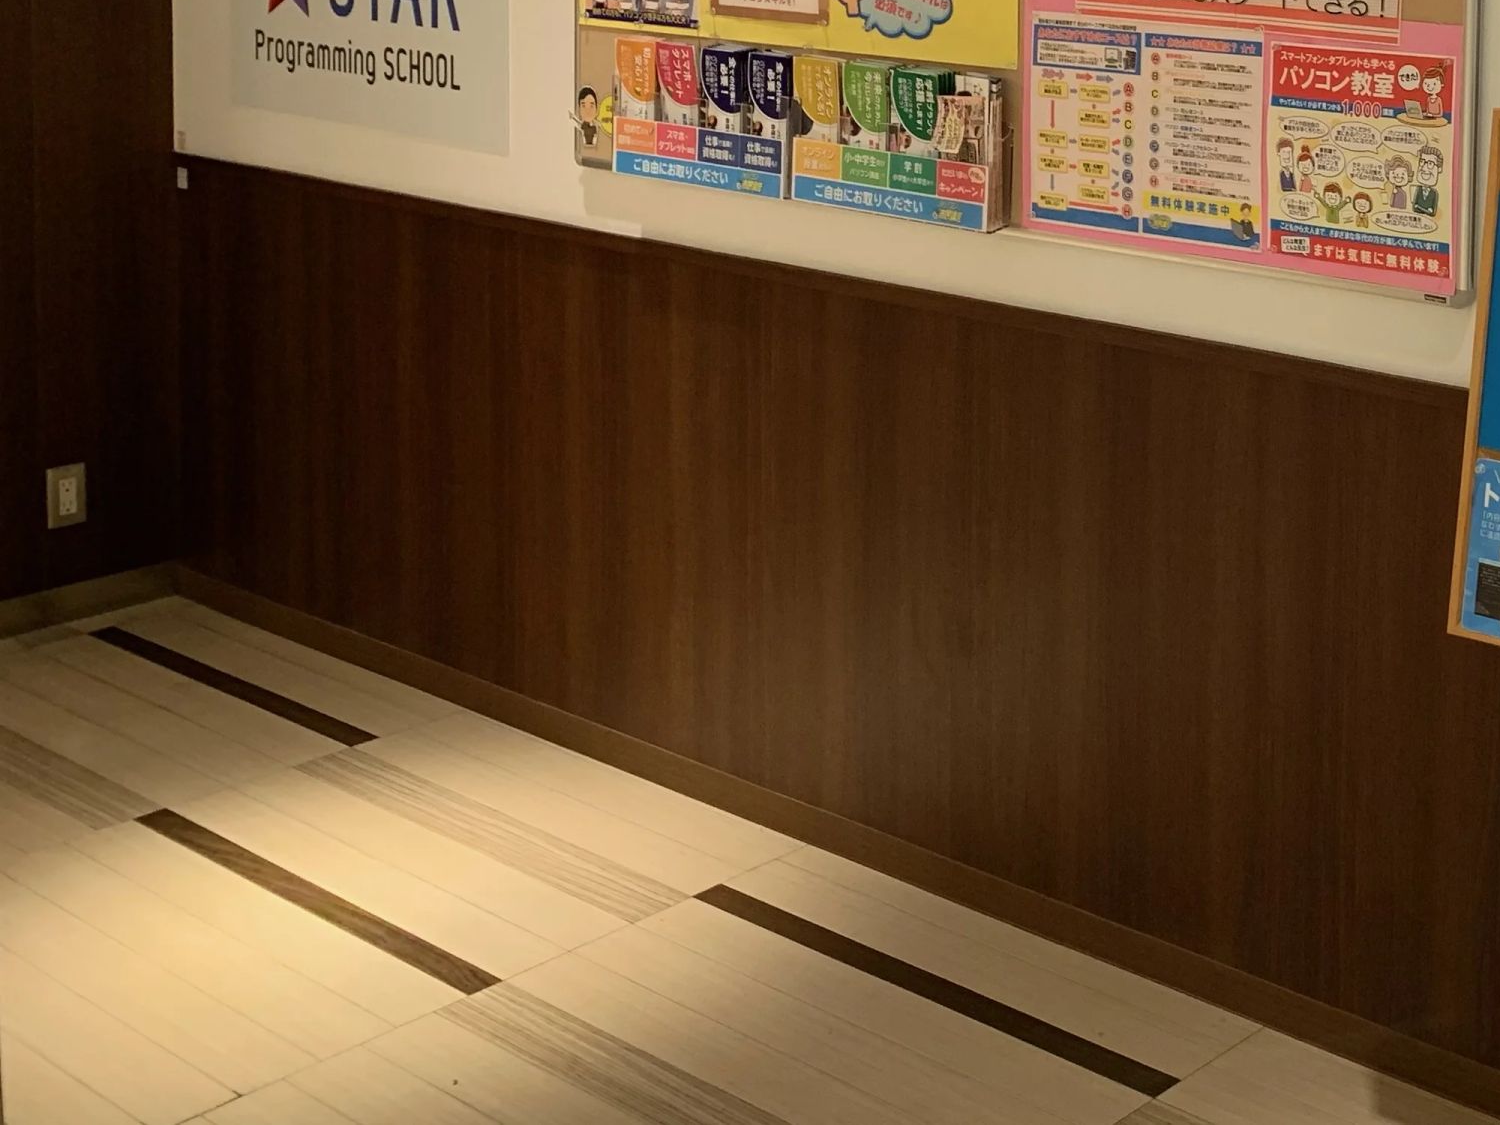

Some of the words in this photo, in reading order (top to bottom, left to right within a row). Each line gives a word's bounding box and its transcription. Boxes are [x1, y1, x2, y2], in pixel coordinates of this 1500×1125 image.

[254, 28, 377, 86] Programming
[383, 45, 461, 92] SCHOOL
[1279, 50, 1396, 71] スマートフォン・タブレットも学べる
[1279, 65, 1395, 99] パソコン教室
[633, 158, 729, 185] ご自由にお取りください
[813, 183, 924, 214] ご自由にお取りください
[1149, 194, 1231, 216] 無料体験実施中
[1313, 244, 1440, 274] まずは気軽に無料体験
